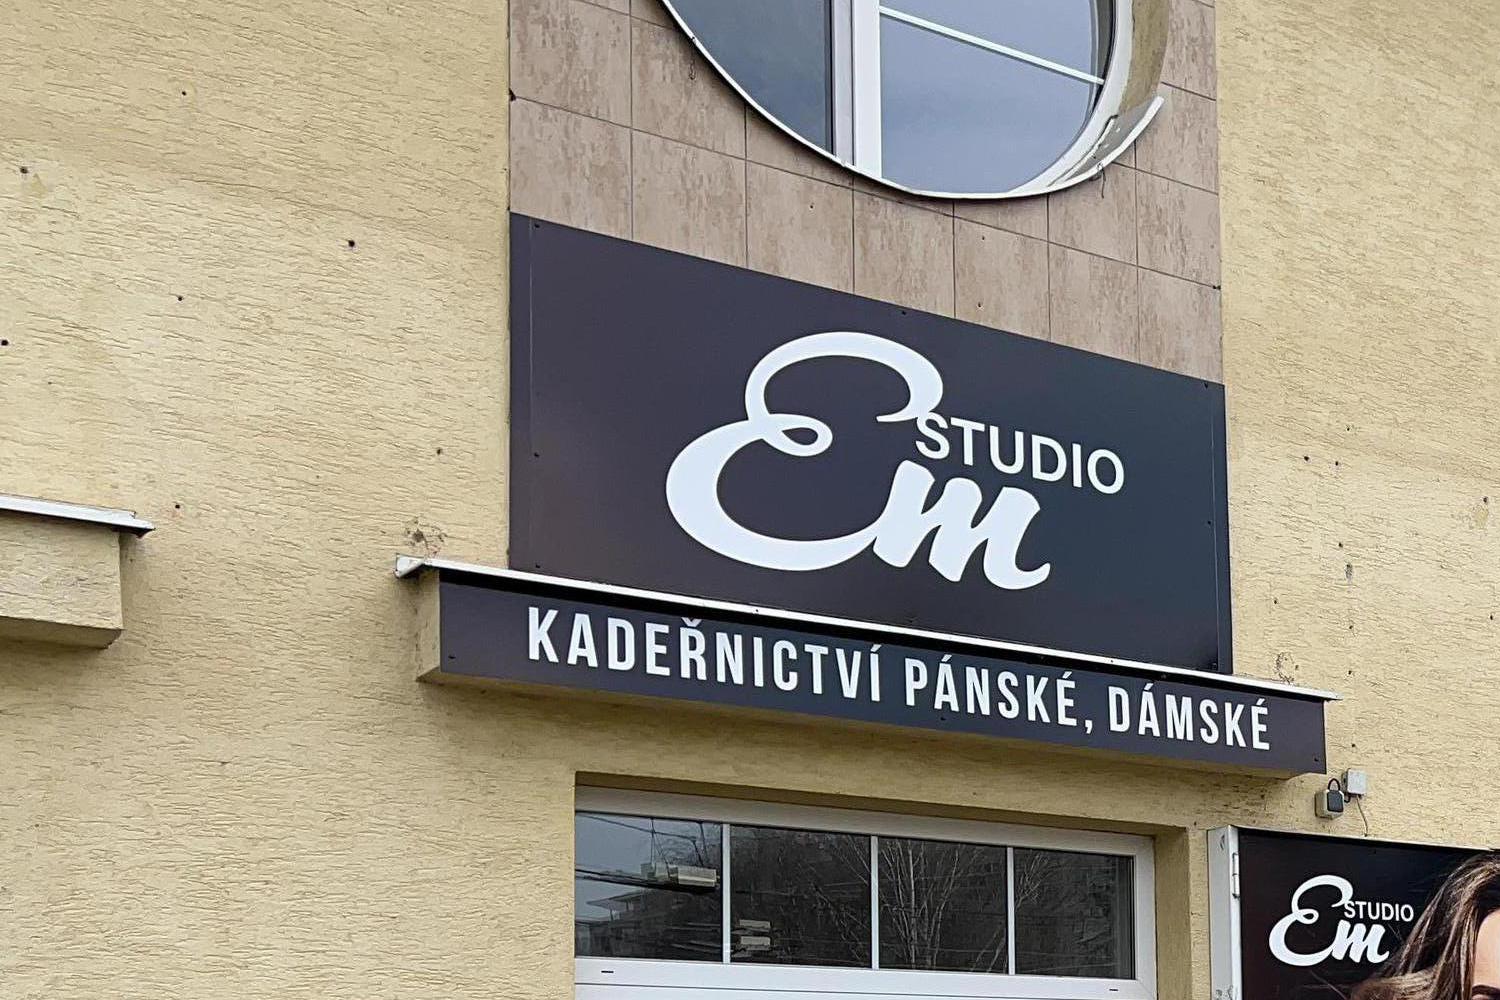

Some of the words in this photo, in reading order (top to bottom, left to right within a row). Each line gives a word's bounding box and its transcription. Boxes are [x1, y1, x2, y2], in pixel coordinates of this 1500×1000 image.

[665, 330, 1052, 591] Em
[915, 411, 1125, 495] STUDIO
[527, 606, 882, 702] KADEŘNICTVÍ
[904, 655, 1093, 735] PÁNSKÉ,
[1108, 683, 1271, 750] DÁMSKÉ
[1268, 874, 1390, 967] Em
[1344, 901, 1414, 922] STUDIO
